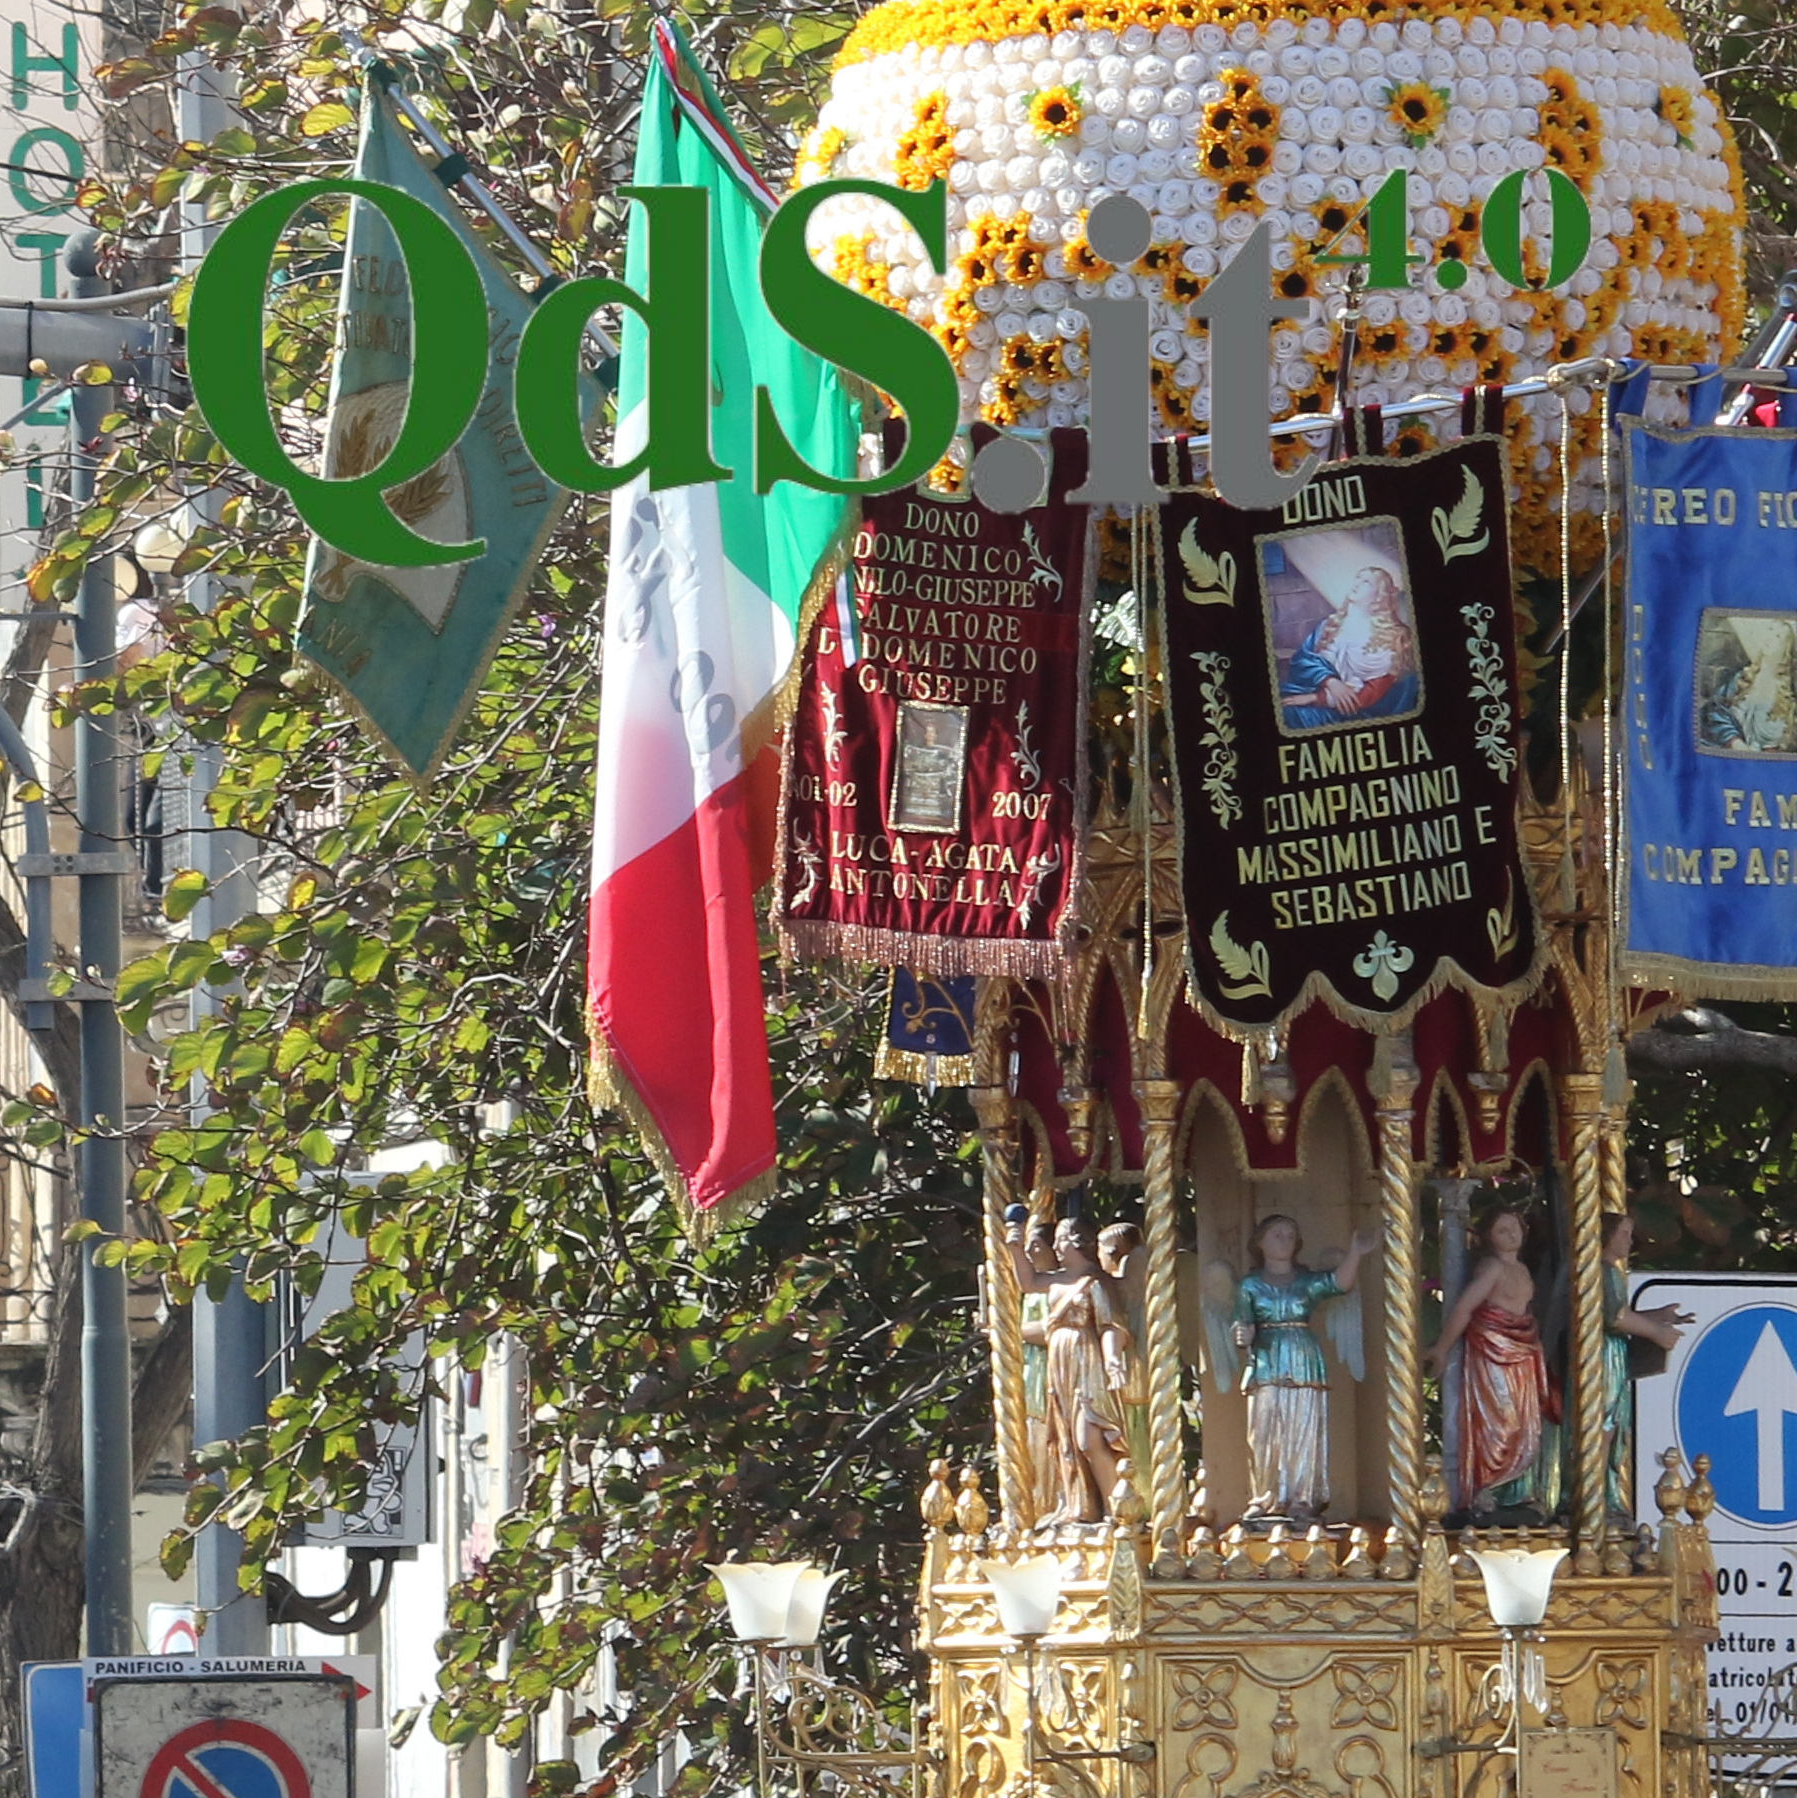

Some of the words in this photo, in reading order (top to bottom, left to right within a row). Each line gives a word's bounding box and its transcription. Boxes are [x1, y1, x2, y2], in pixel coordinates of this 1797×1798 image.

[905, 503, 980, 537] DONO
[852, 531, 1022, 575] DOMENICO
[862, 631, 1038, 674] DOMENICO
[858, 664, 1008, 704] GIUSEPPE
[1278, 724, 1433, 784] FAMIGLIA
[991, 791, 1053, 821] 2007
[1264, 765, 1460, 836] COMPAGNINO
[1237, 814, 1461, 885] MASSIMILIANO
[1475, 806, 1497, 846] E
[829, 863, 1017, 908] ANTONELLA
[1271, 861, 1472, 930] SEBASTIANO
[95, 1661, 185, 1674] PANIFICIO
[200, 1660, 306, 1674] SALUMERIA
